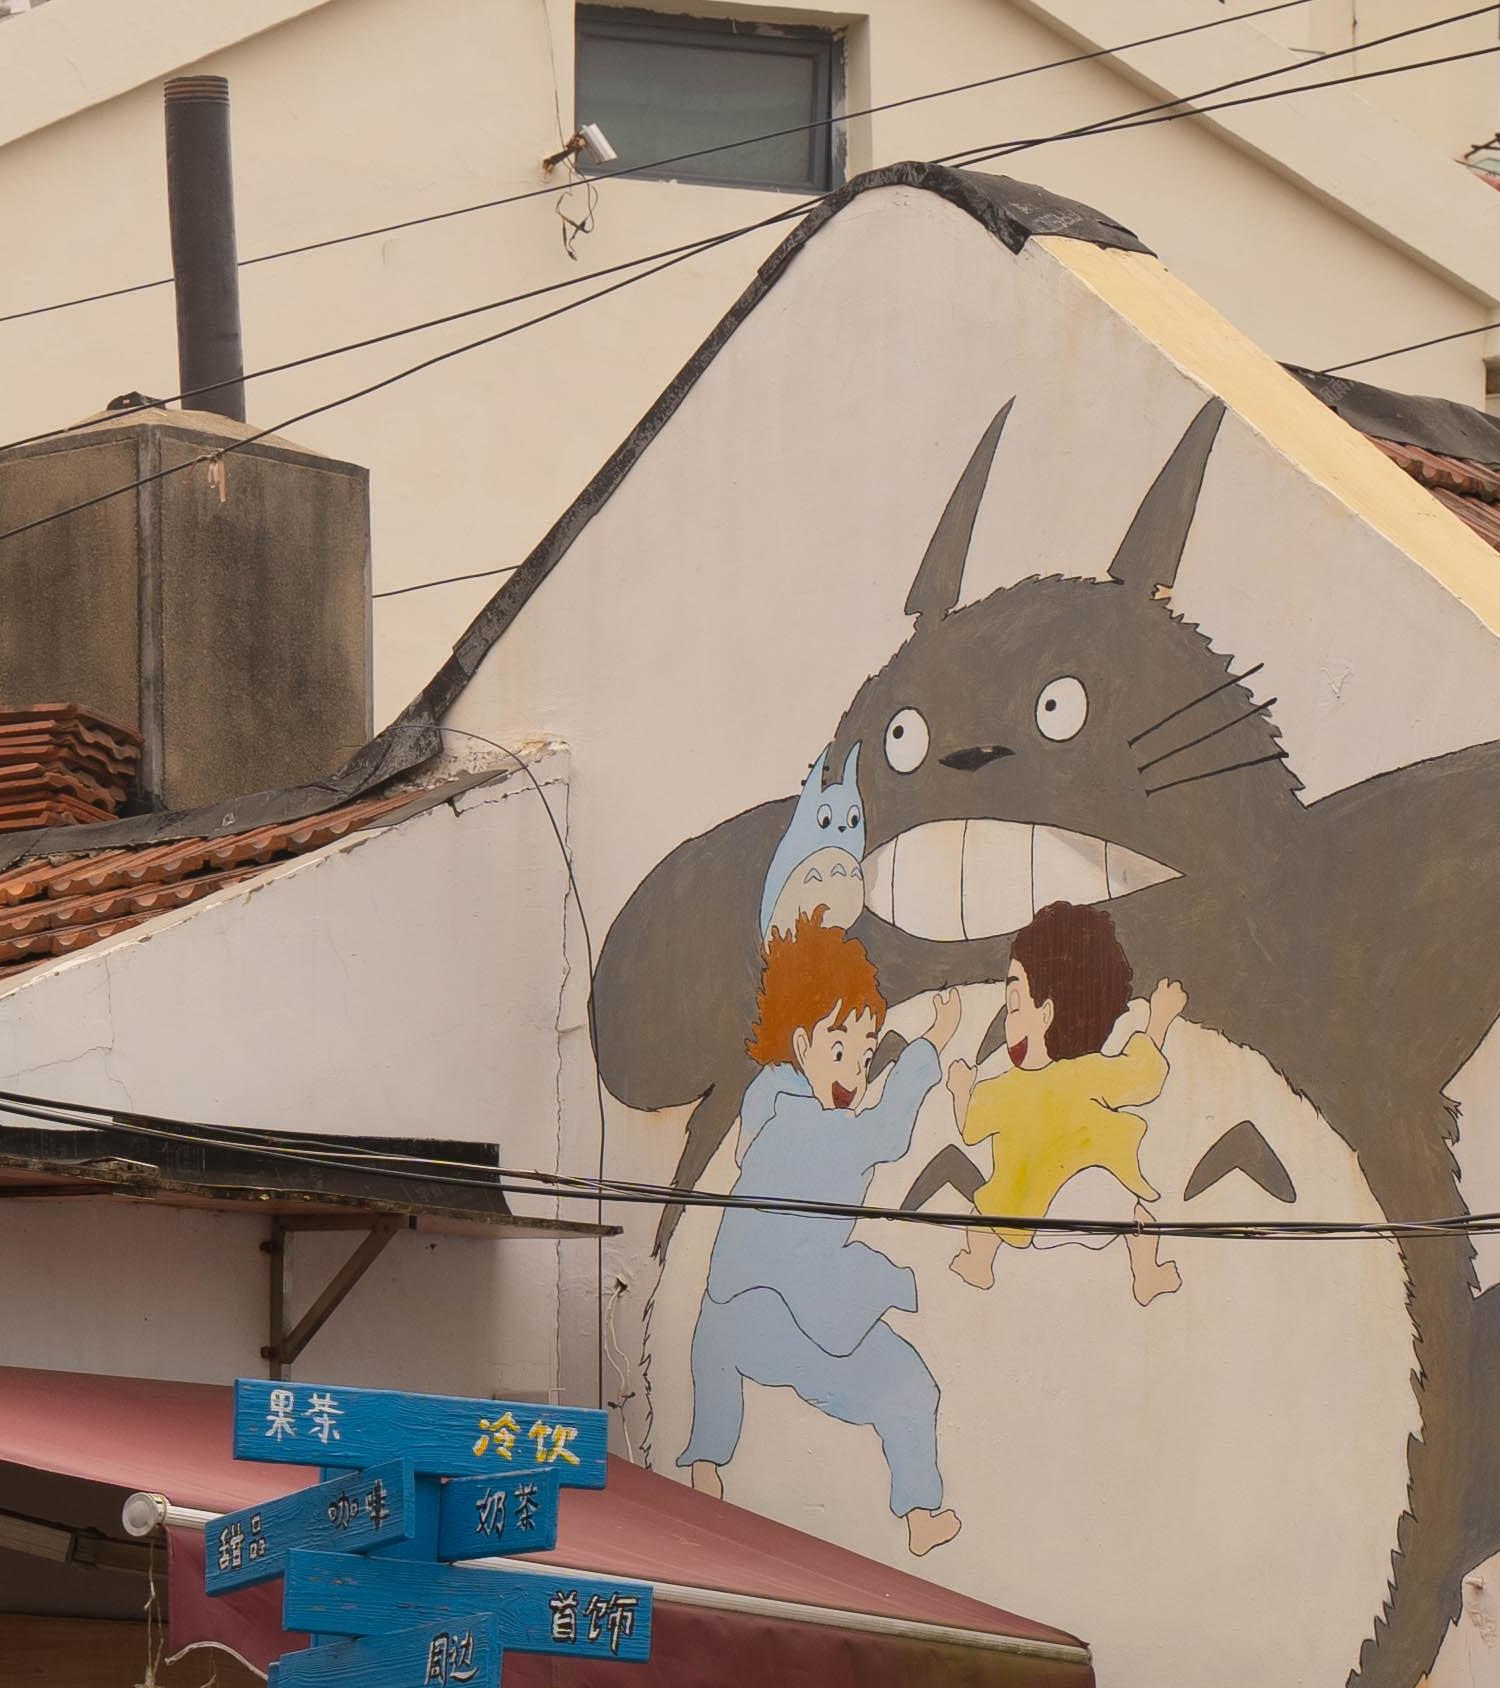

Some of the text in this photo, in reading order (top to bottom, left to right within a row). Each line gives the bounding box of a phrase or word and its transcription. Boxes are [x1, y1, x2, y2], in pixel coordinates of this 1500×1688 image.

[266, 1388, 344, 1442] 果茶
[472, 1410, 581, 1466] 冷饮
[217, 1479, 391, 1571] 甜品 咖啡
[475, 1481, 540, 1537] 奶茶
[548, 1590, 639, 1655] 首饰
[424, 1629, 481, 1688] 周边
